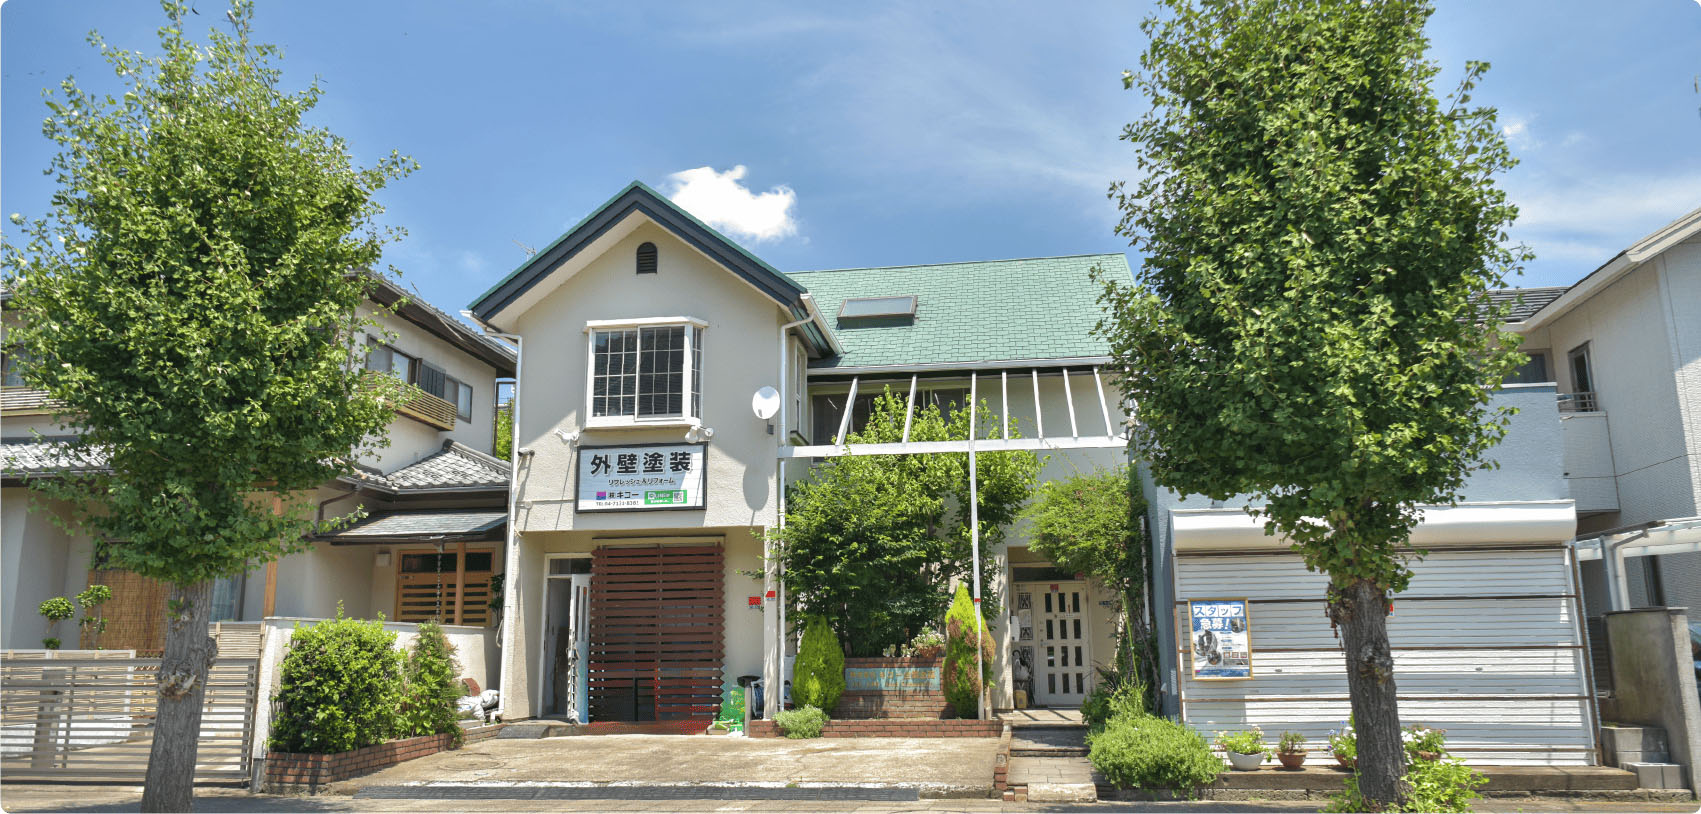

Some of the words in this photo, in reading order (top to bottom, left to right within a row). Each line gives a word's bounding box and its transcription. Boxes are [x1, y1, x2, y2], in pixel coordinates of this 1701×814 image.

[590, 452, 691, 475] 外壁塗装
[1194, 606, 1242, 616] スタッフ
[1200, 618, 1230, 630] 急募!
